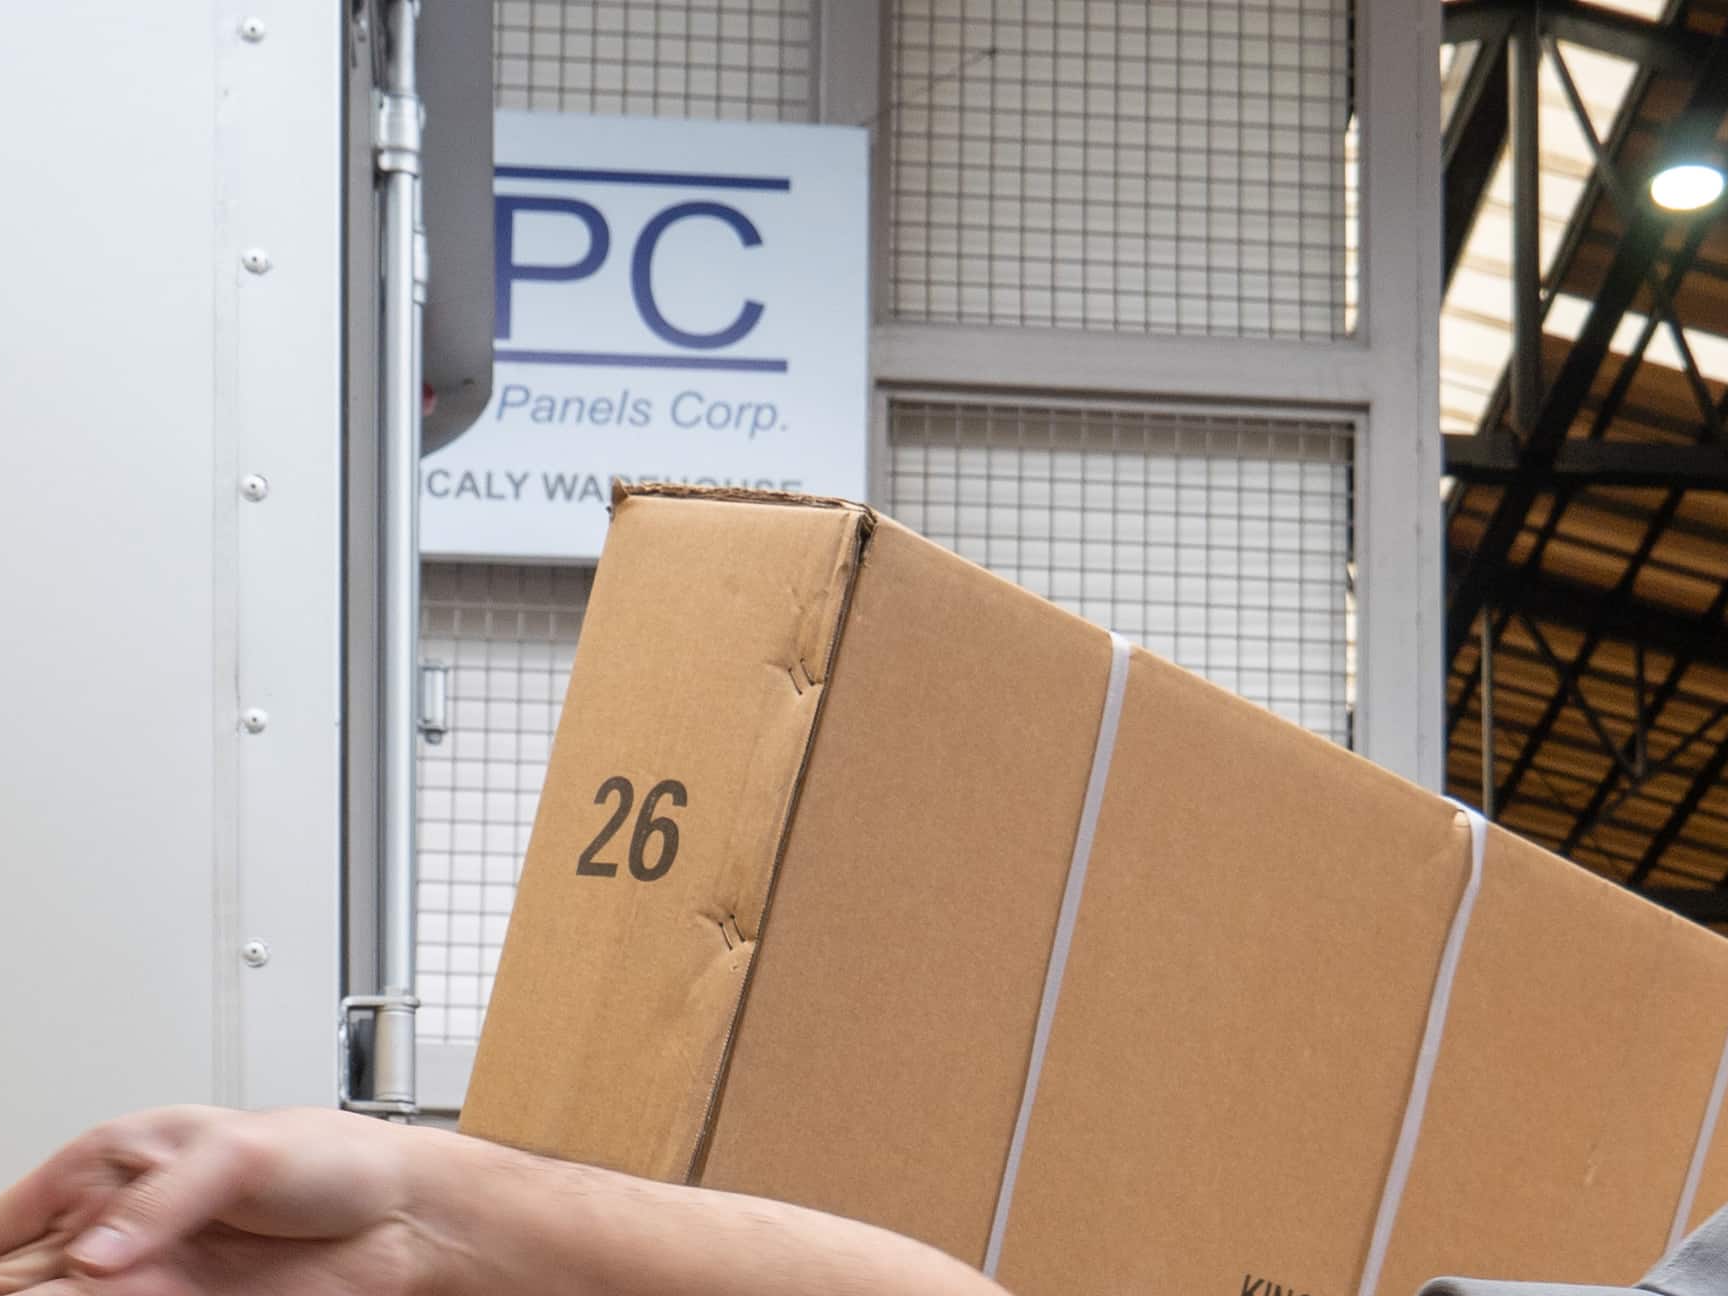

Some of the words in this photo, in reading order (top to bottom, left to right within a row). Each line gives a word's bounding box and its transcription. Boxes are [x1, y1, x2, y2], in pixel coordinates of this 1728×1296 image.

[496, 384, 652, 426] Panels
[671, 390, 788, 439] Corp.
[576, 776, 688, 882] 26
